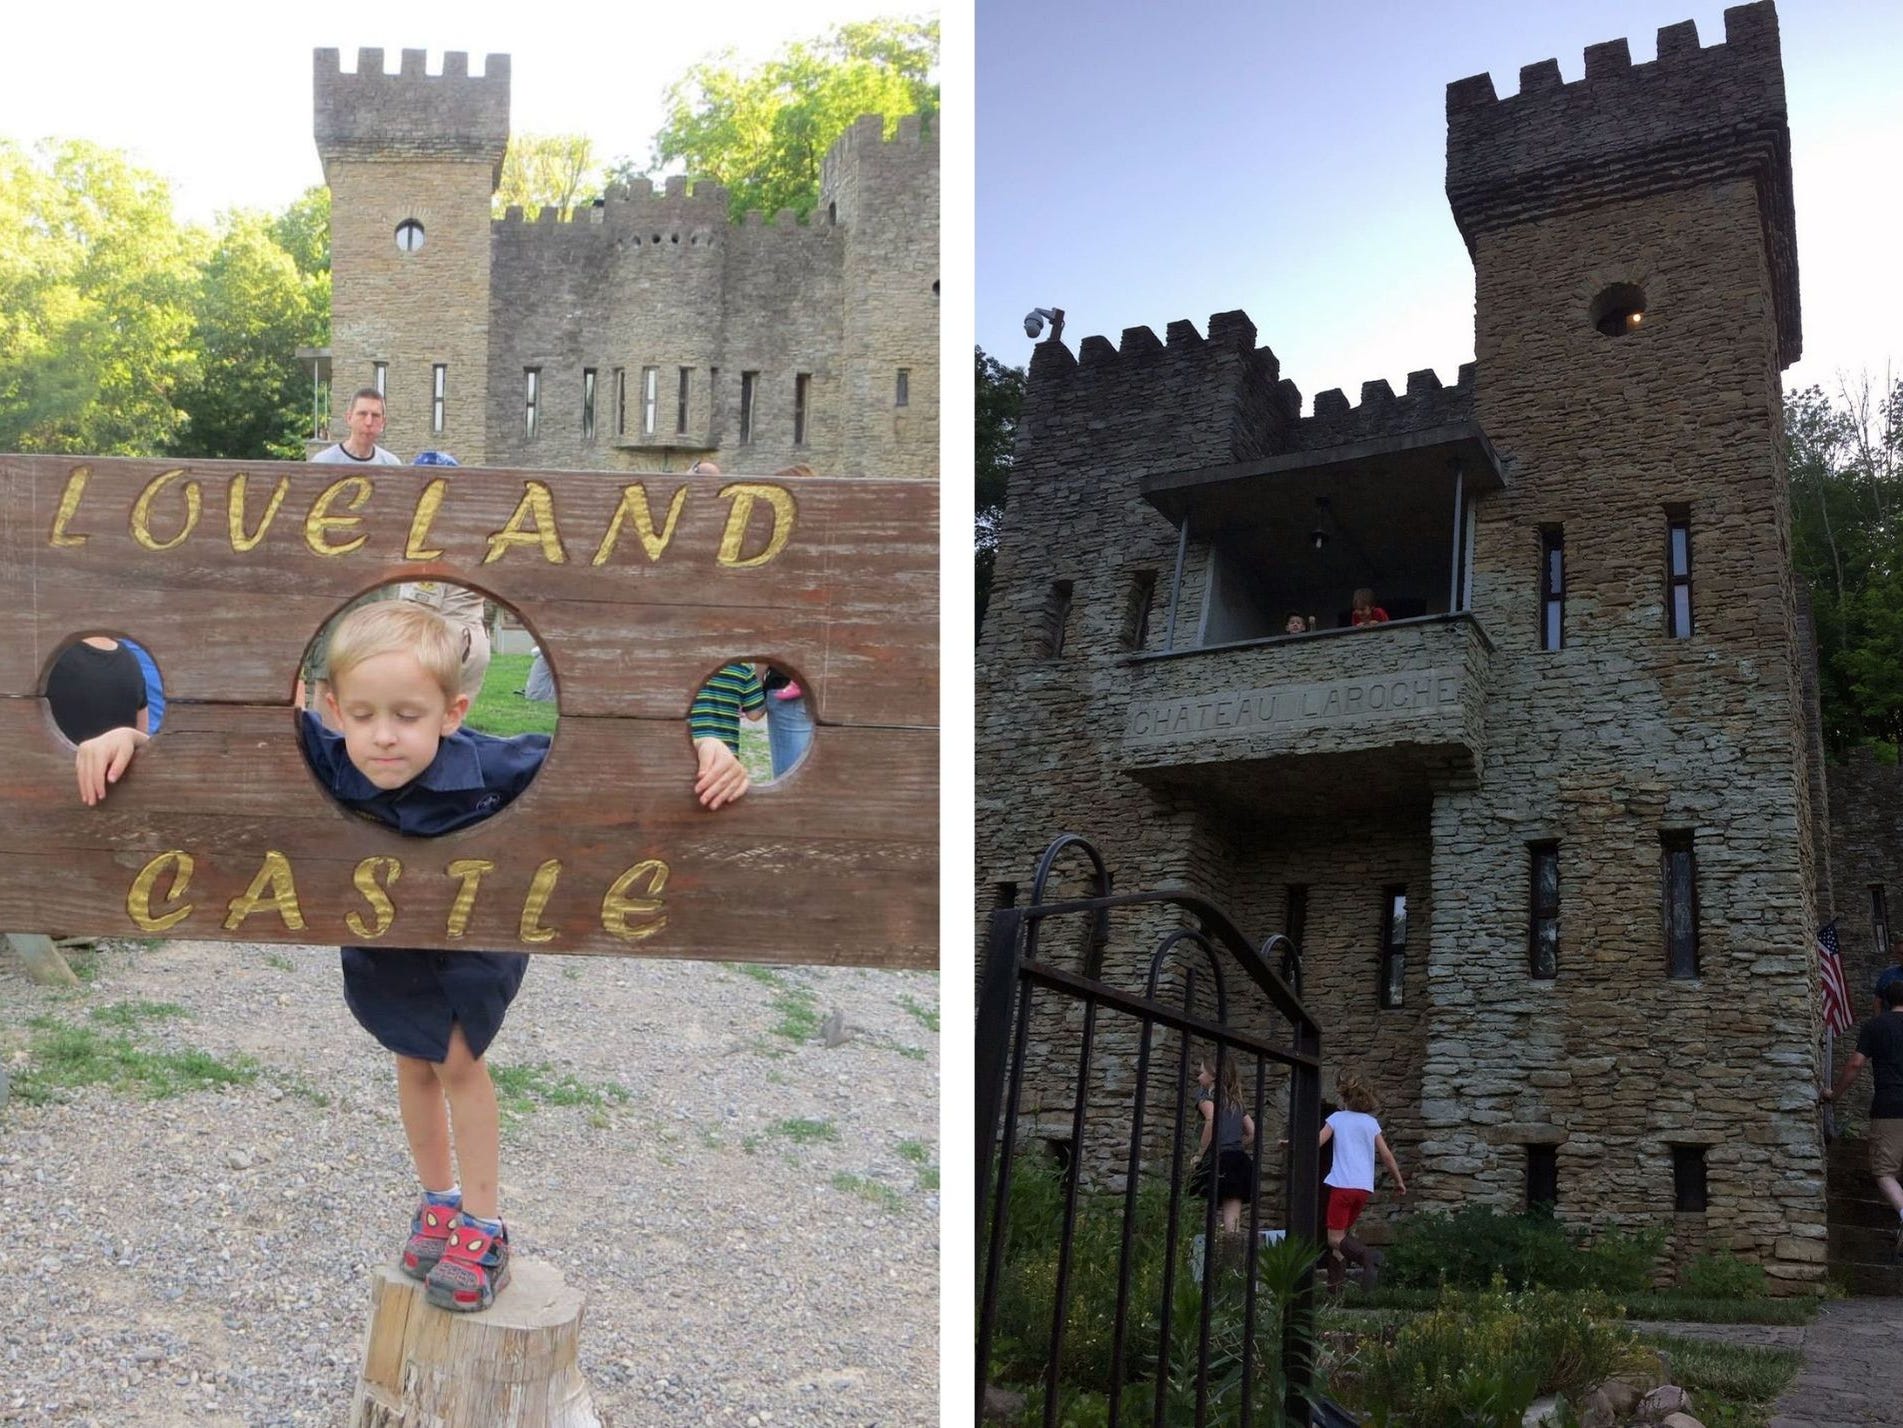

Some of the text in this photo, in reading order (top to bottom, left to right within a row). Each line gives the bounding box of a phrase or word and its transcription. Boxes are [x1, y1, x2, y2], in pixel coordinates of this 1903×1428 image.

[48, 465, 798, 569] LOVELAND
[1130, 676, 1457, 736] CHATEAU LAROCHE
[126, 850, 670, 944] CASTLE
